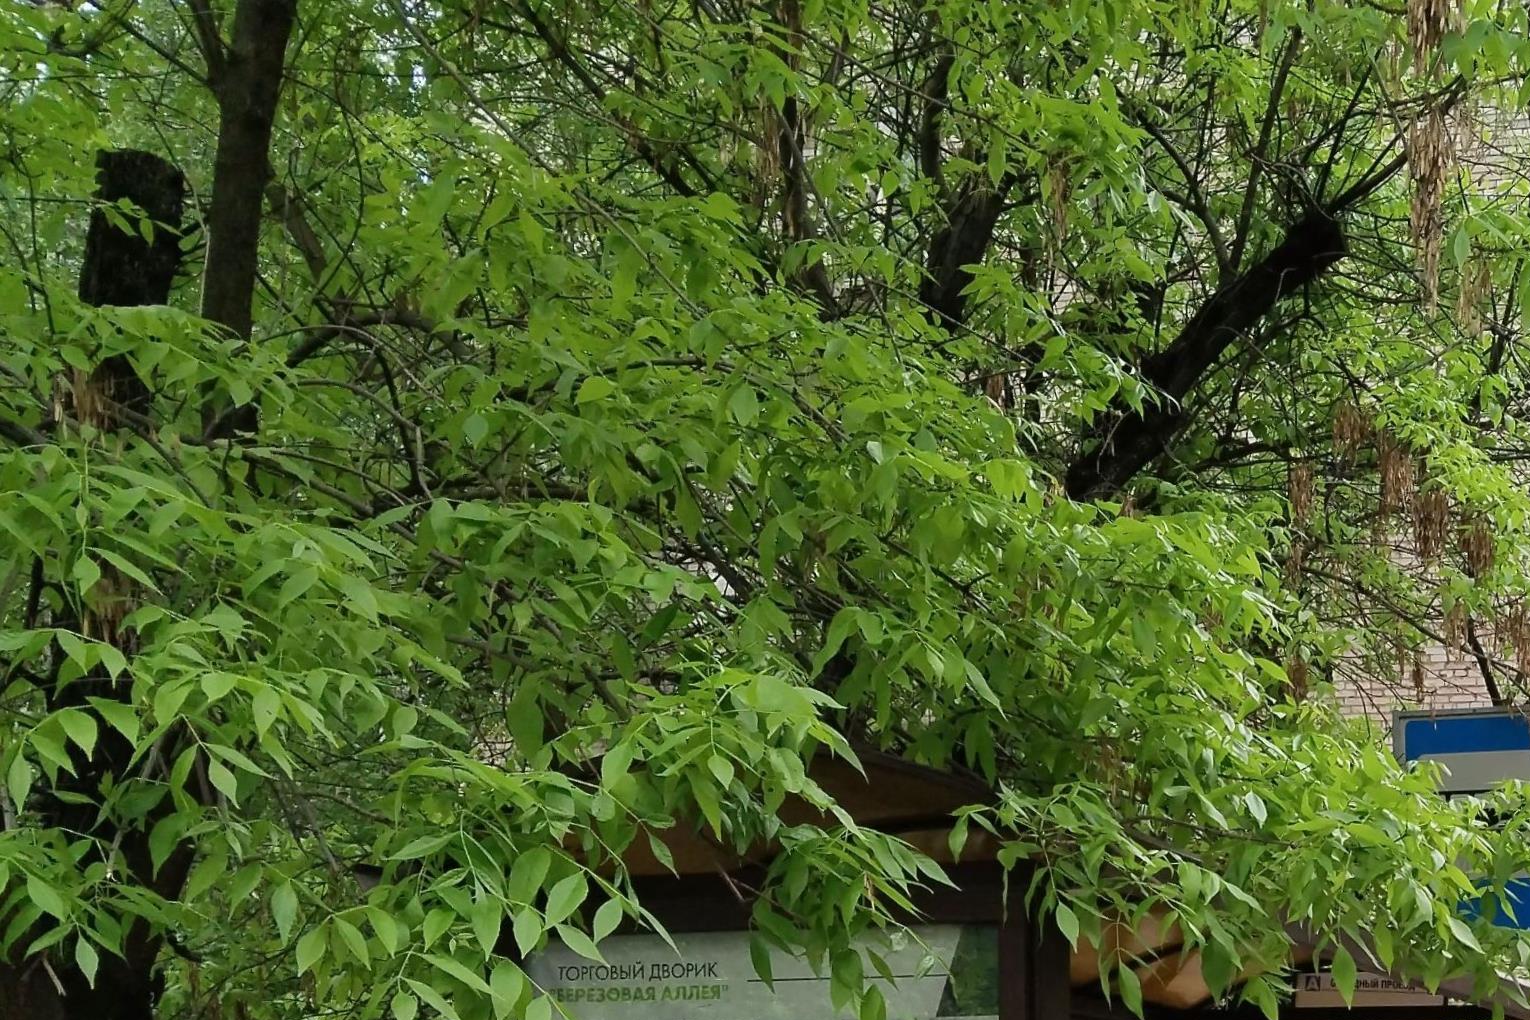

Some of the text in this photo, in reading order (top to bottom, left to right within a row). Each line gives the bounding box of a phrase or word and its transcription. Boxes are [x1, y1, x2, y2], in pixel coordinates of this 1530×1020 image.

[558, 961, 718, 982] ТОРГОВЫЙ ДВОРИК
[661, 985, 729, 1001] АЛЛЕЯ"
